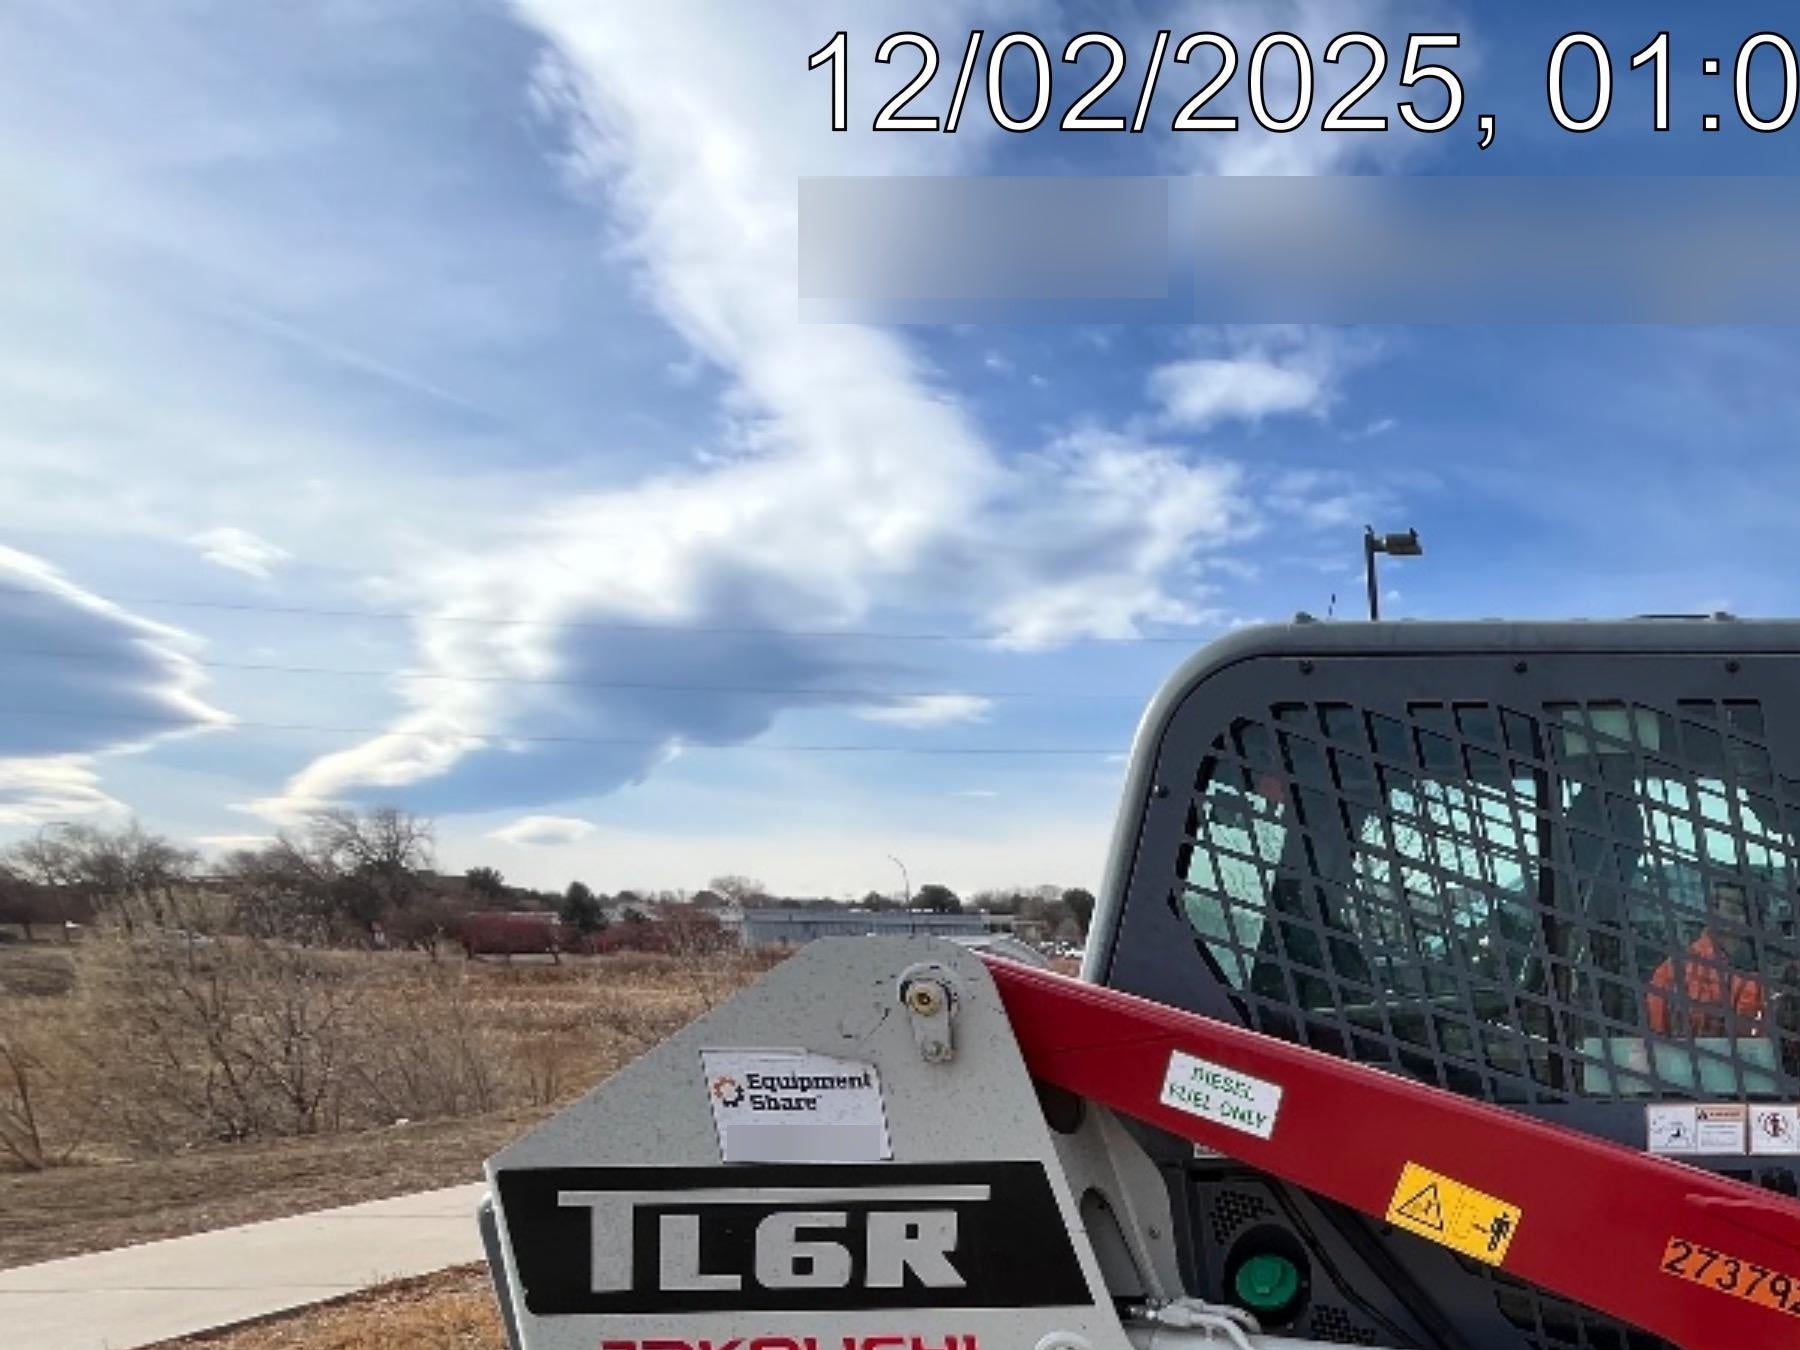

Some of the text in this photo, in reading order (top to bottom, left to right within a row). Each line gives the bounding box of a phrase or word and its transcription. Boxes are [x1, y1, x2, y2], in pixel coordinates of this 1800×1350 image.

[746, 1071, 872, 1092] Equipment
[750, 1094, 818, 1111] Share
[557, 1184, 991, 1294] TL6R
